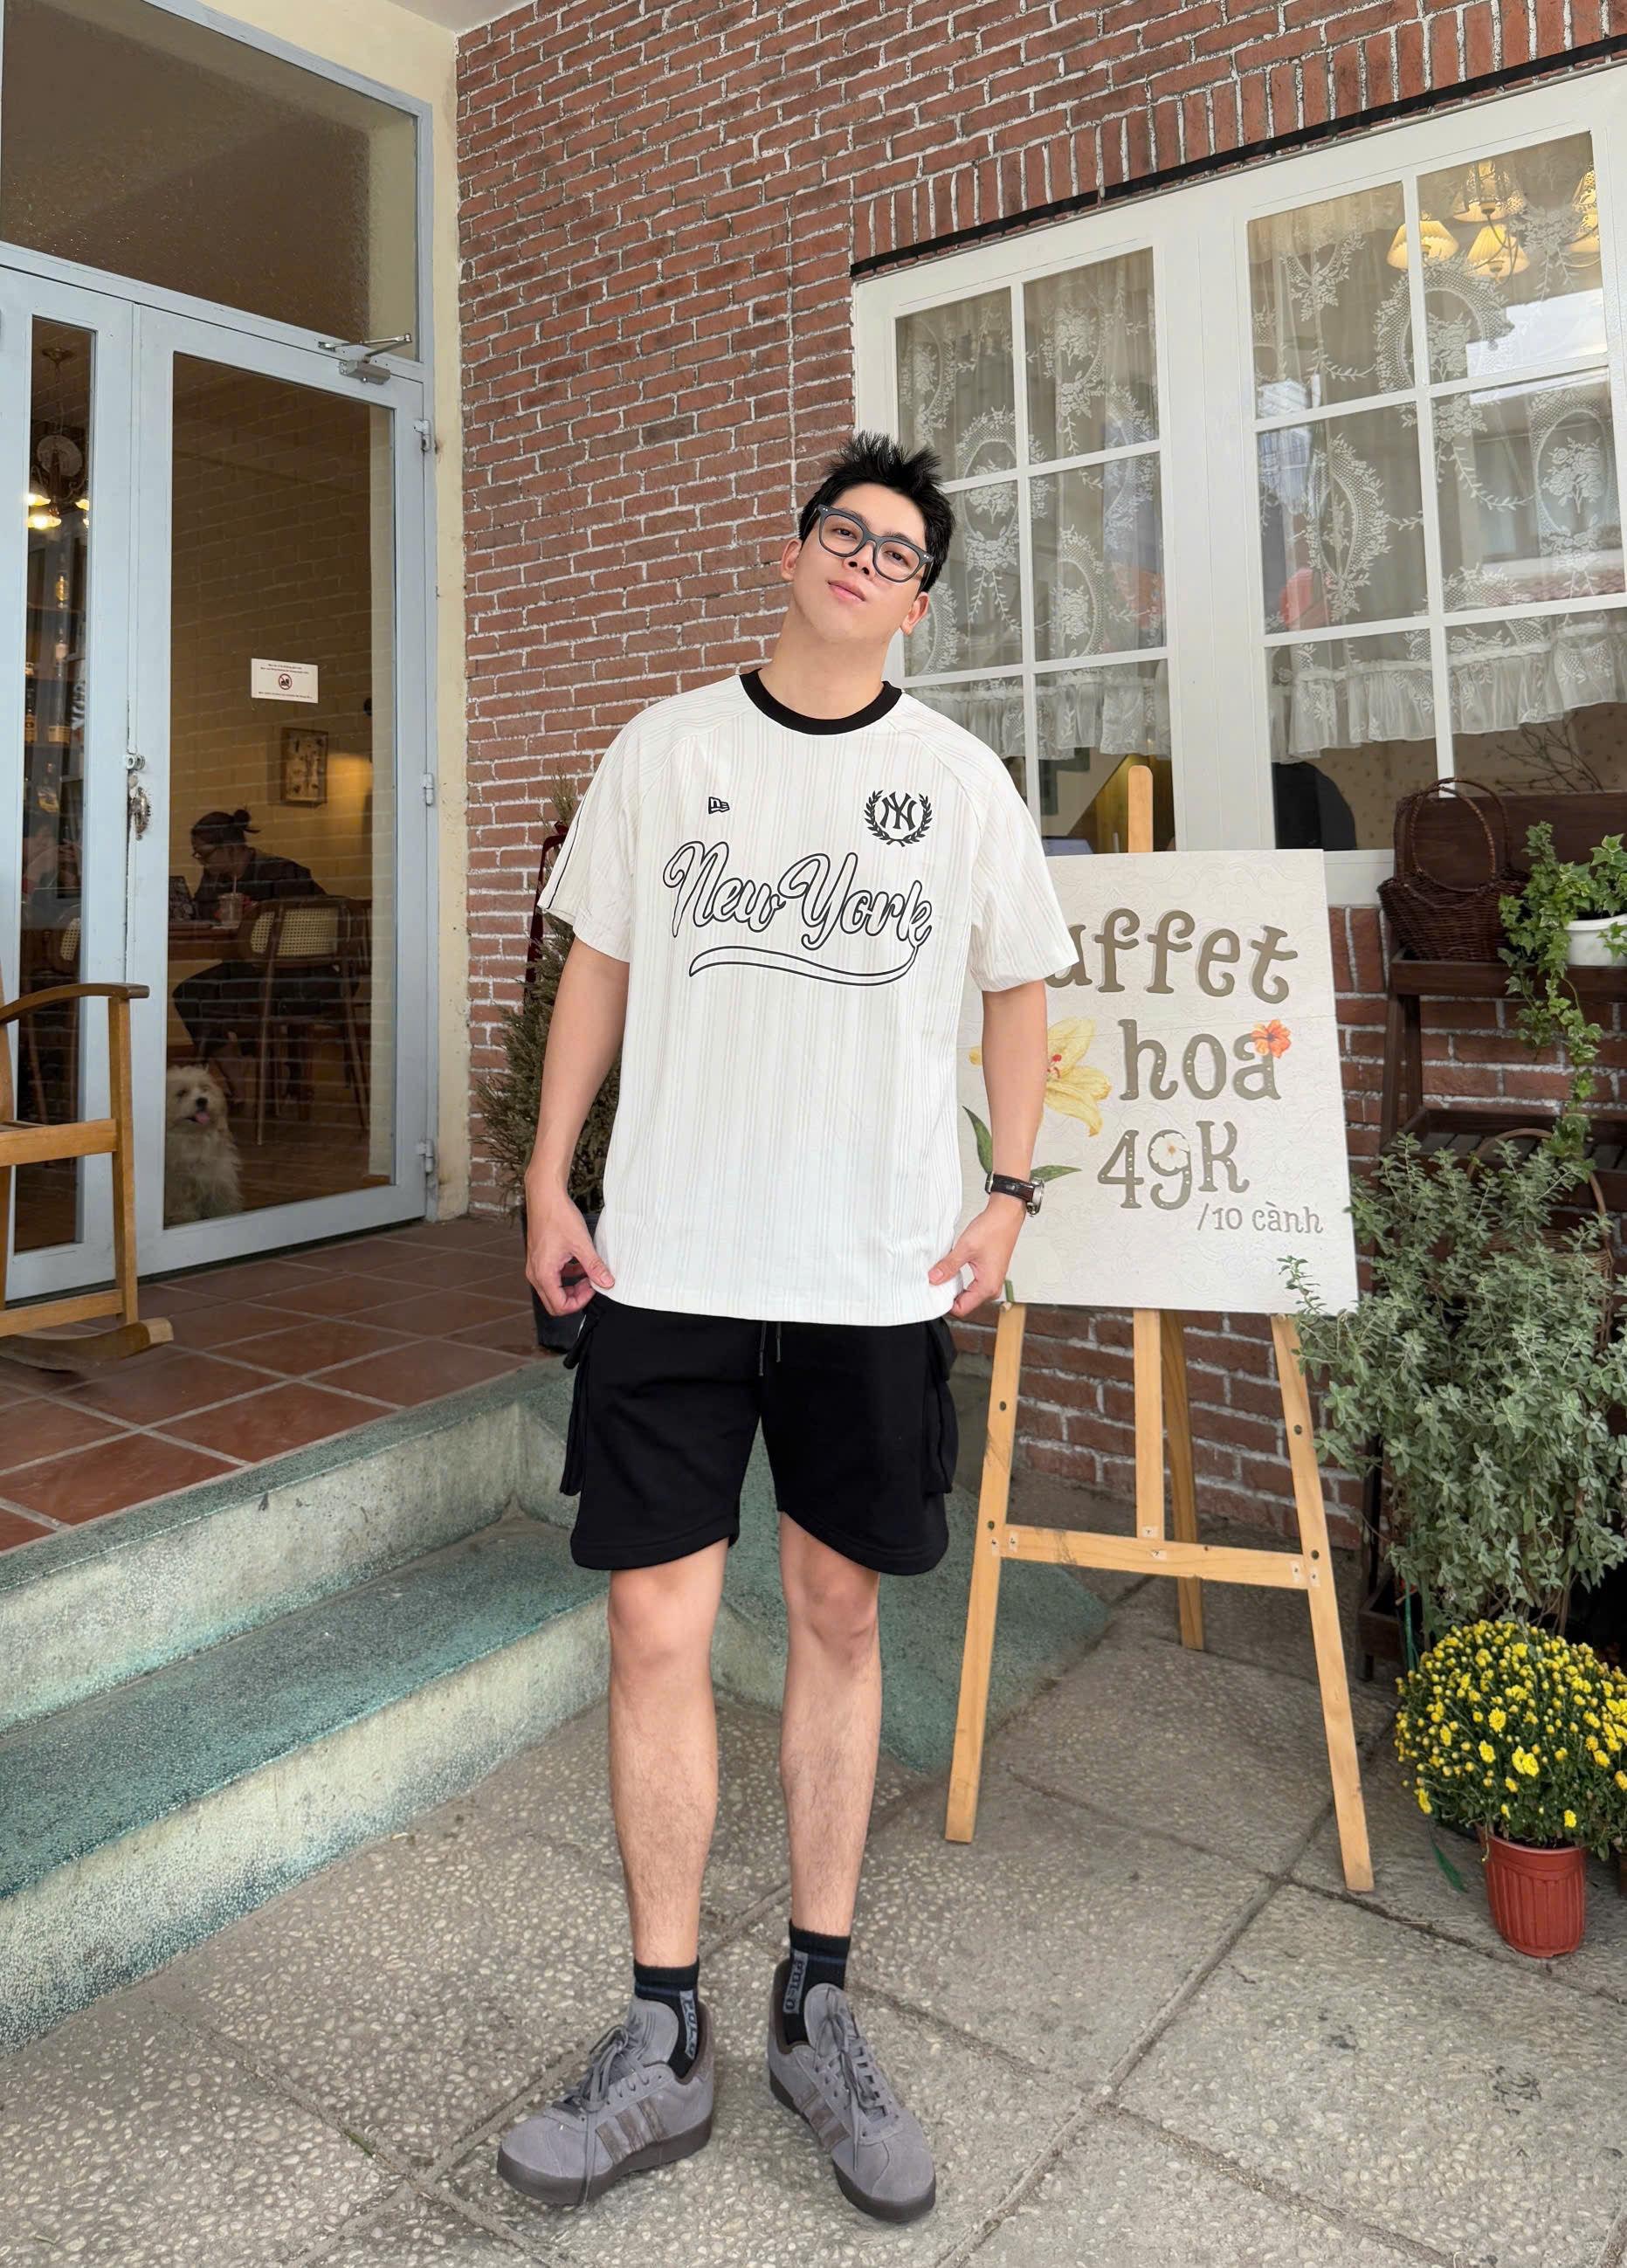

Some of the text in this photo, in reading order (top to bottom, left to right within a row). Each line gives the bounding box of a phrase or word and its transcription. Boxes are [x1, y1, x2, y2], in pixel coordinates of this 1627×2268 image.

[879, 791, 918, 831] NY
[663, 840, 933, 950] New York
[1118, 1018, 1282, 1100] hoa
[1097, 1120, 1251, 1210] 49K
[1197, 1201, 1324, 1234] /10 cành
